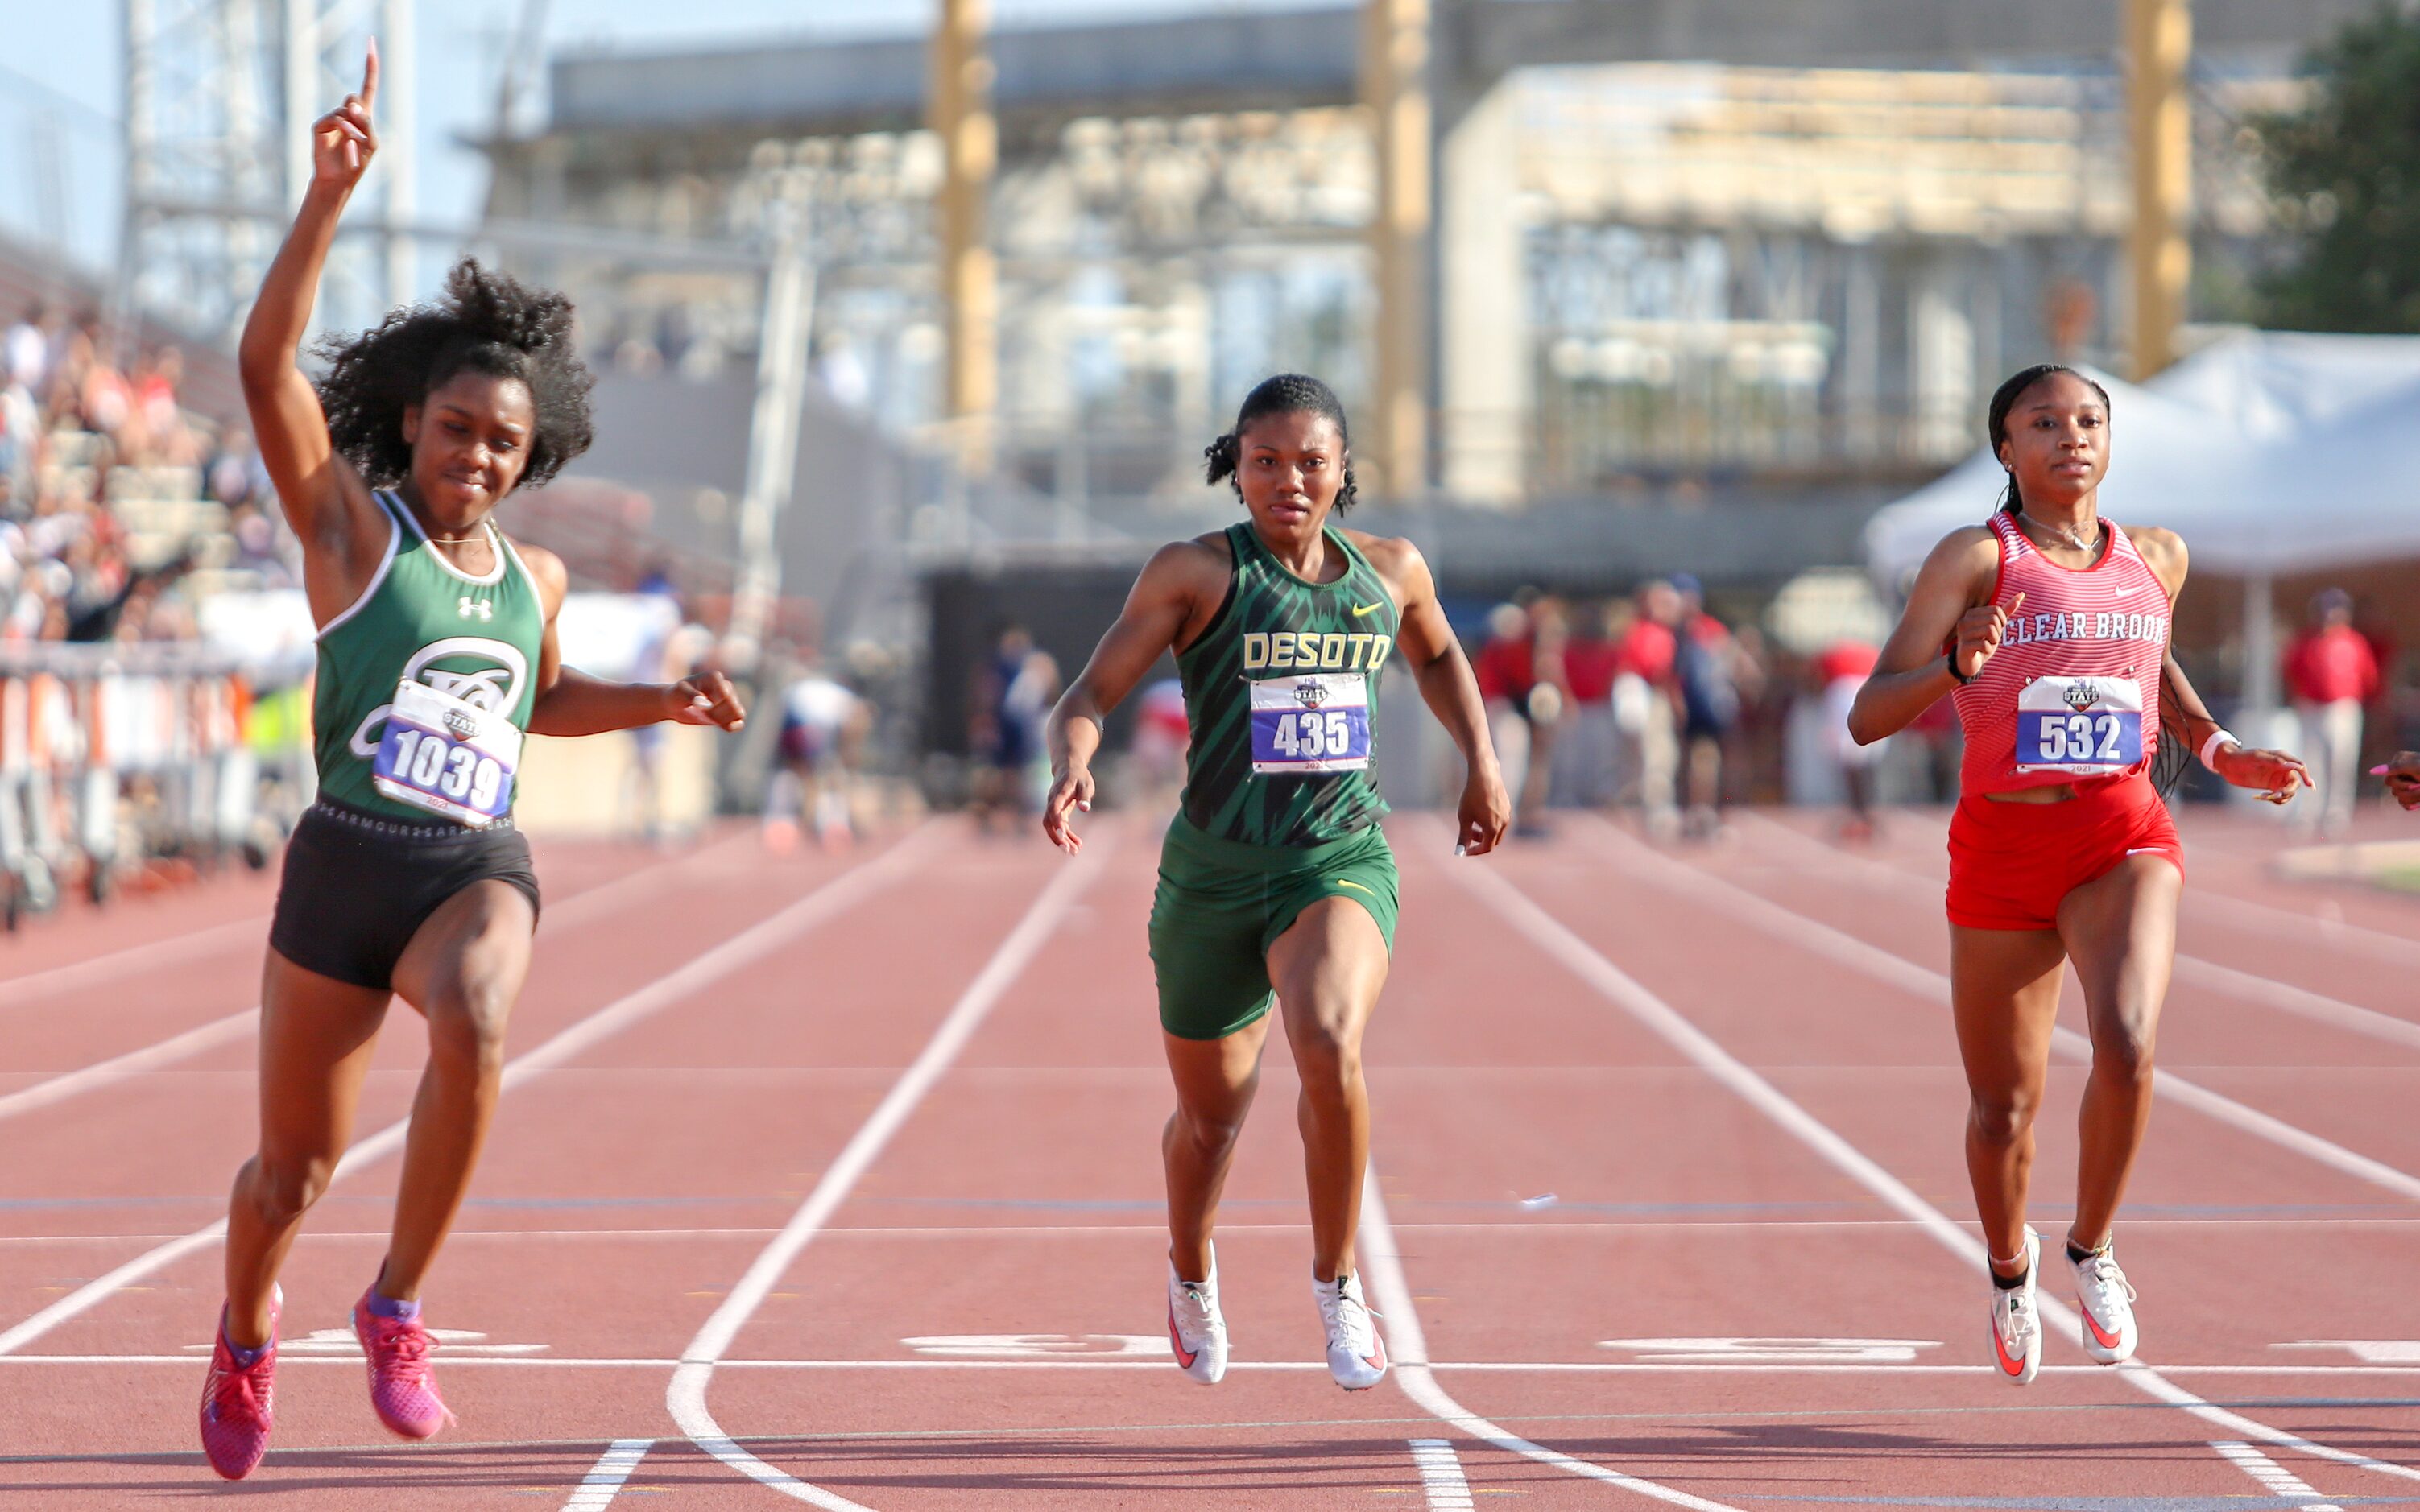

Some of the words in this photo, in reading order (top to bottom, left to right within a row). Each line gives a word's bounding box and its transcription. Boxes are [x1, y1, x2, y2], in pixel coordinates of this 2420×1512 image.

[2003, 612, 2086, 646] CLEAR
[1243, 632, 1392, 670] DESOTO
[2063, 690, 2099, 702] STATE
[443, 712, 482, 734] STAT
[1273, 712, 1349, 756] 435
[2039, 715, 2121, 760] 532
[393, 729, 502, 810] 1039
[2070, 765, 2091, 773] 2021
[425, 795, 449, 810] 2021
[335, 810, 409, 837] ARMOUR
